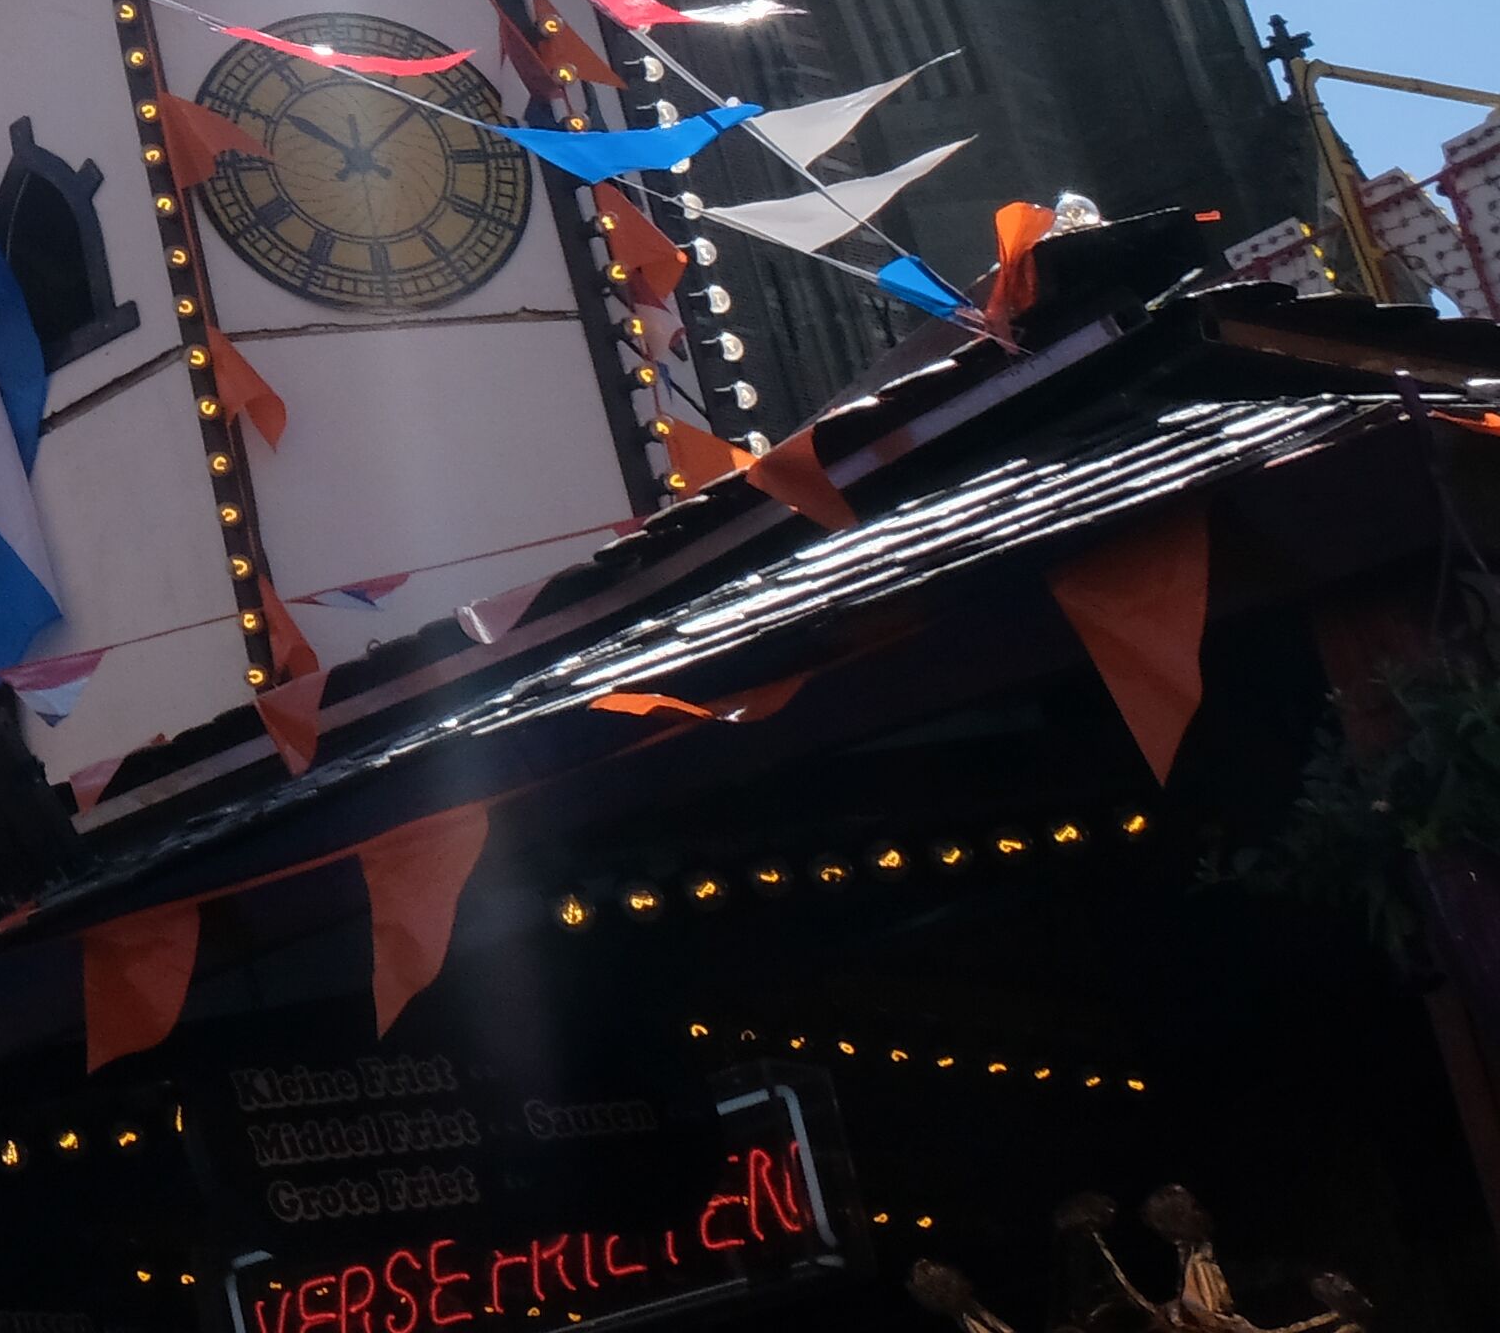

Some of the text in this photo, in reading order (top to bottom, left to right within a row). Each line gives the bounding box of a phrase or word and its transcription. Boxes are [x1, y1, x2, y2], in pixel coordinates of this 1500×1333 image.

[230, 1052, 459, 1111] Kleine Friet
[248, 1107, 482, 1167] Middel Friet
[522, 1097, 658, 1140] Sausen
[266, 1164, 482, 1223] Grote Friet
[255, 1237, 474, 1333] VERSE
